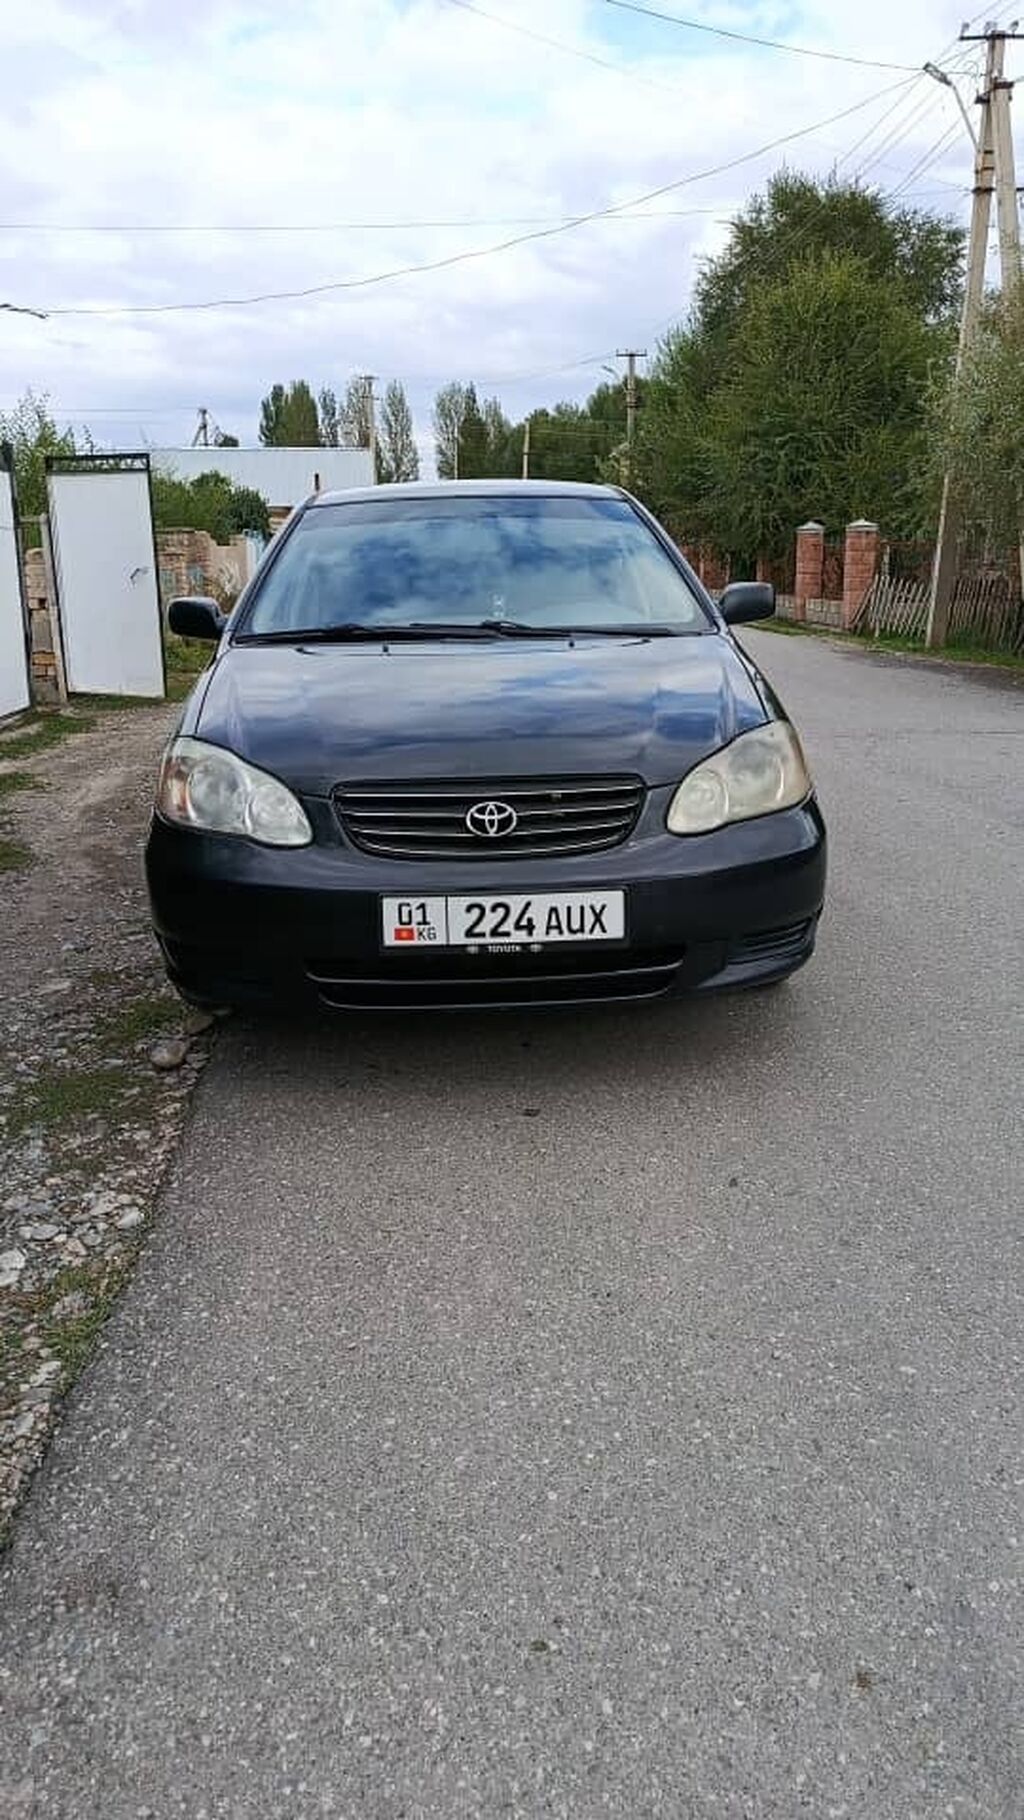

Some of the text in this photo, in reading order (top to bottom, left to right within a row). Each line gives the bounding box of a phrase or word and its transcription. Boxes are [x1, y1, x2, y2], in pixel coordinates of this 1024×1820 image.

[398, 901, 608, 939] 01 224 AUX
[417, 926, 437, 941] KG
